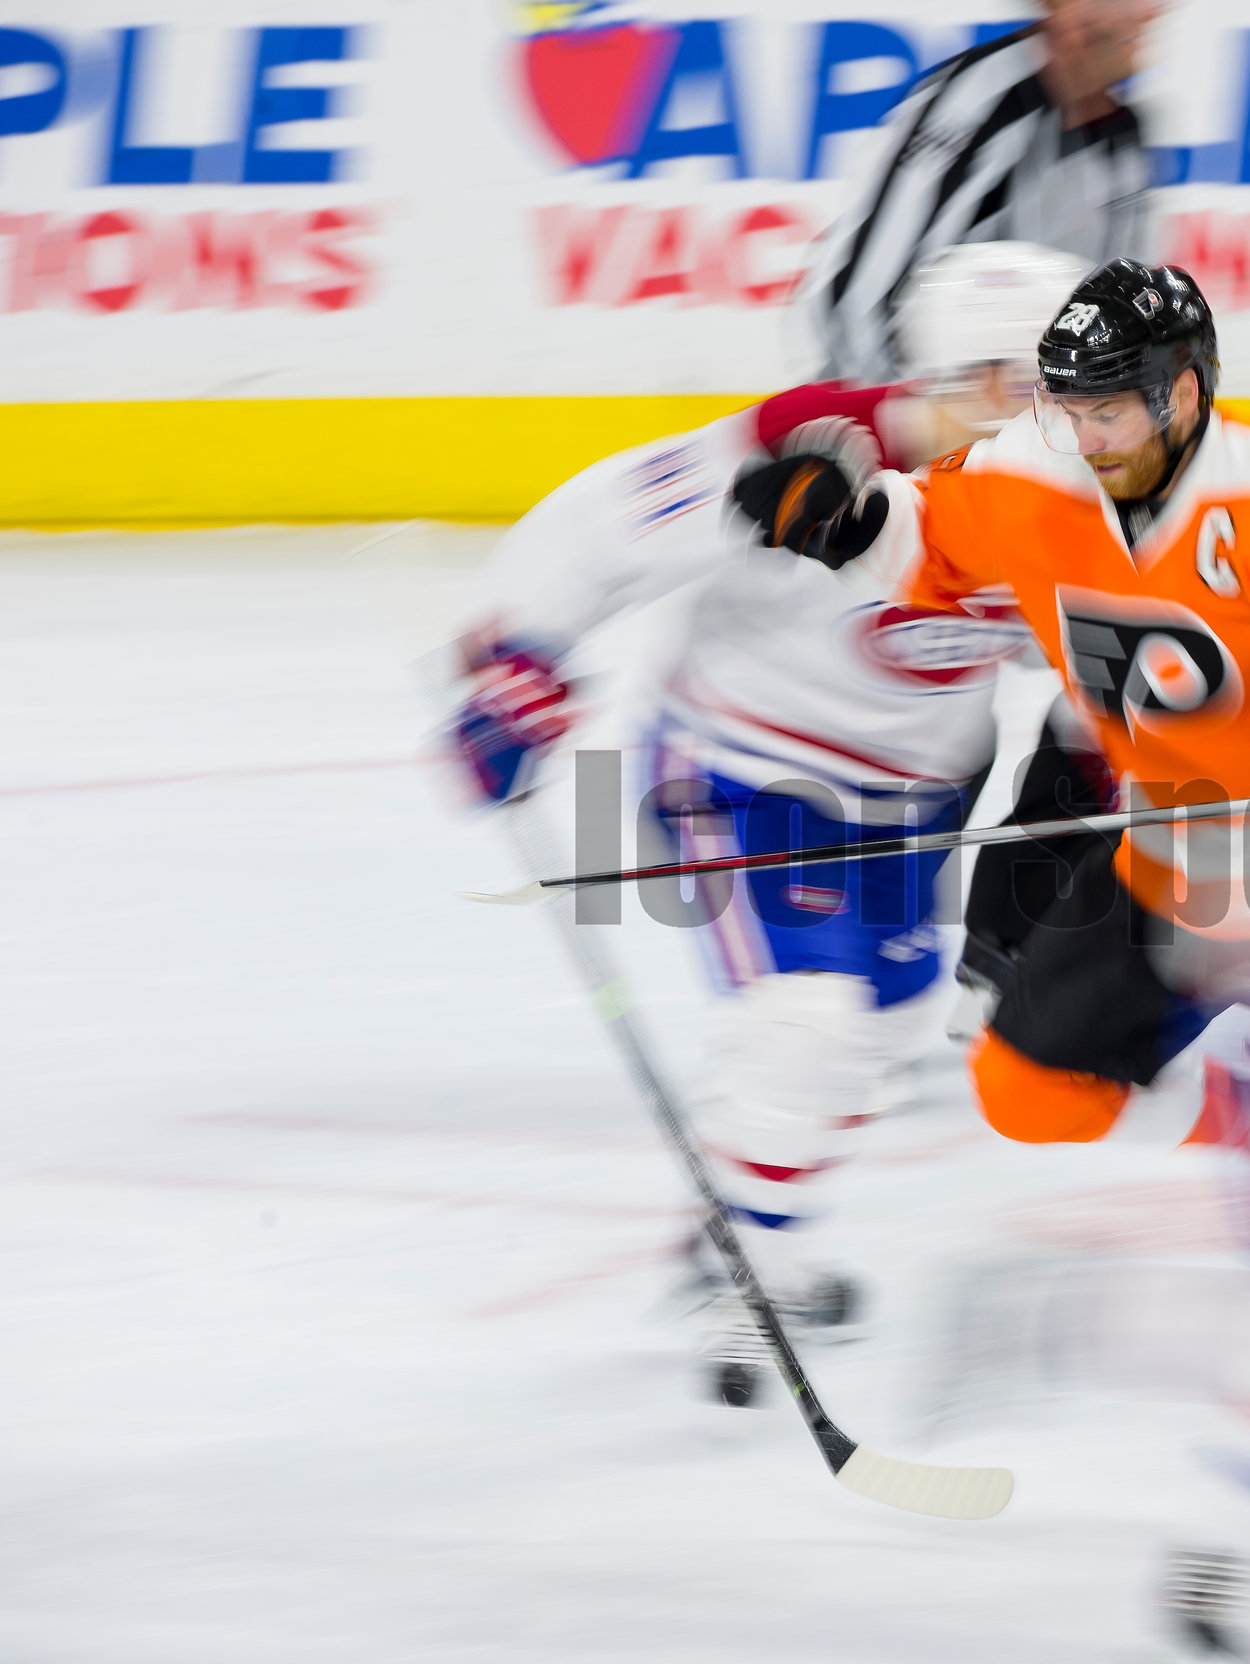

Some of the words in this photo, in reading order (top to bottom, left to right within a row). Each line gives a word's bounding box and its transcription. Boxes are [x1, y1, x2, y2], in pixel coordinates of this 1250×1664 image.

[1054, 302, 1101, 336] 28
[1043, 365, 1078, 378] BAUER
[1195, 506, 1242, 600] C
